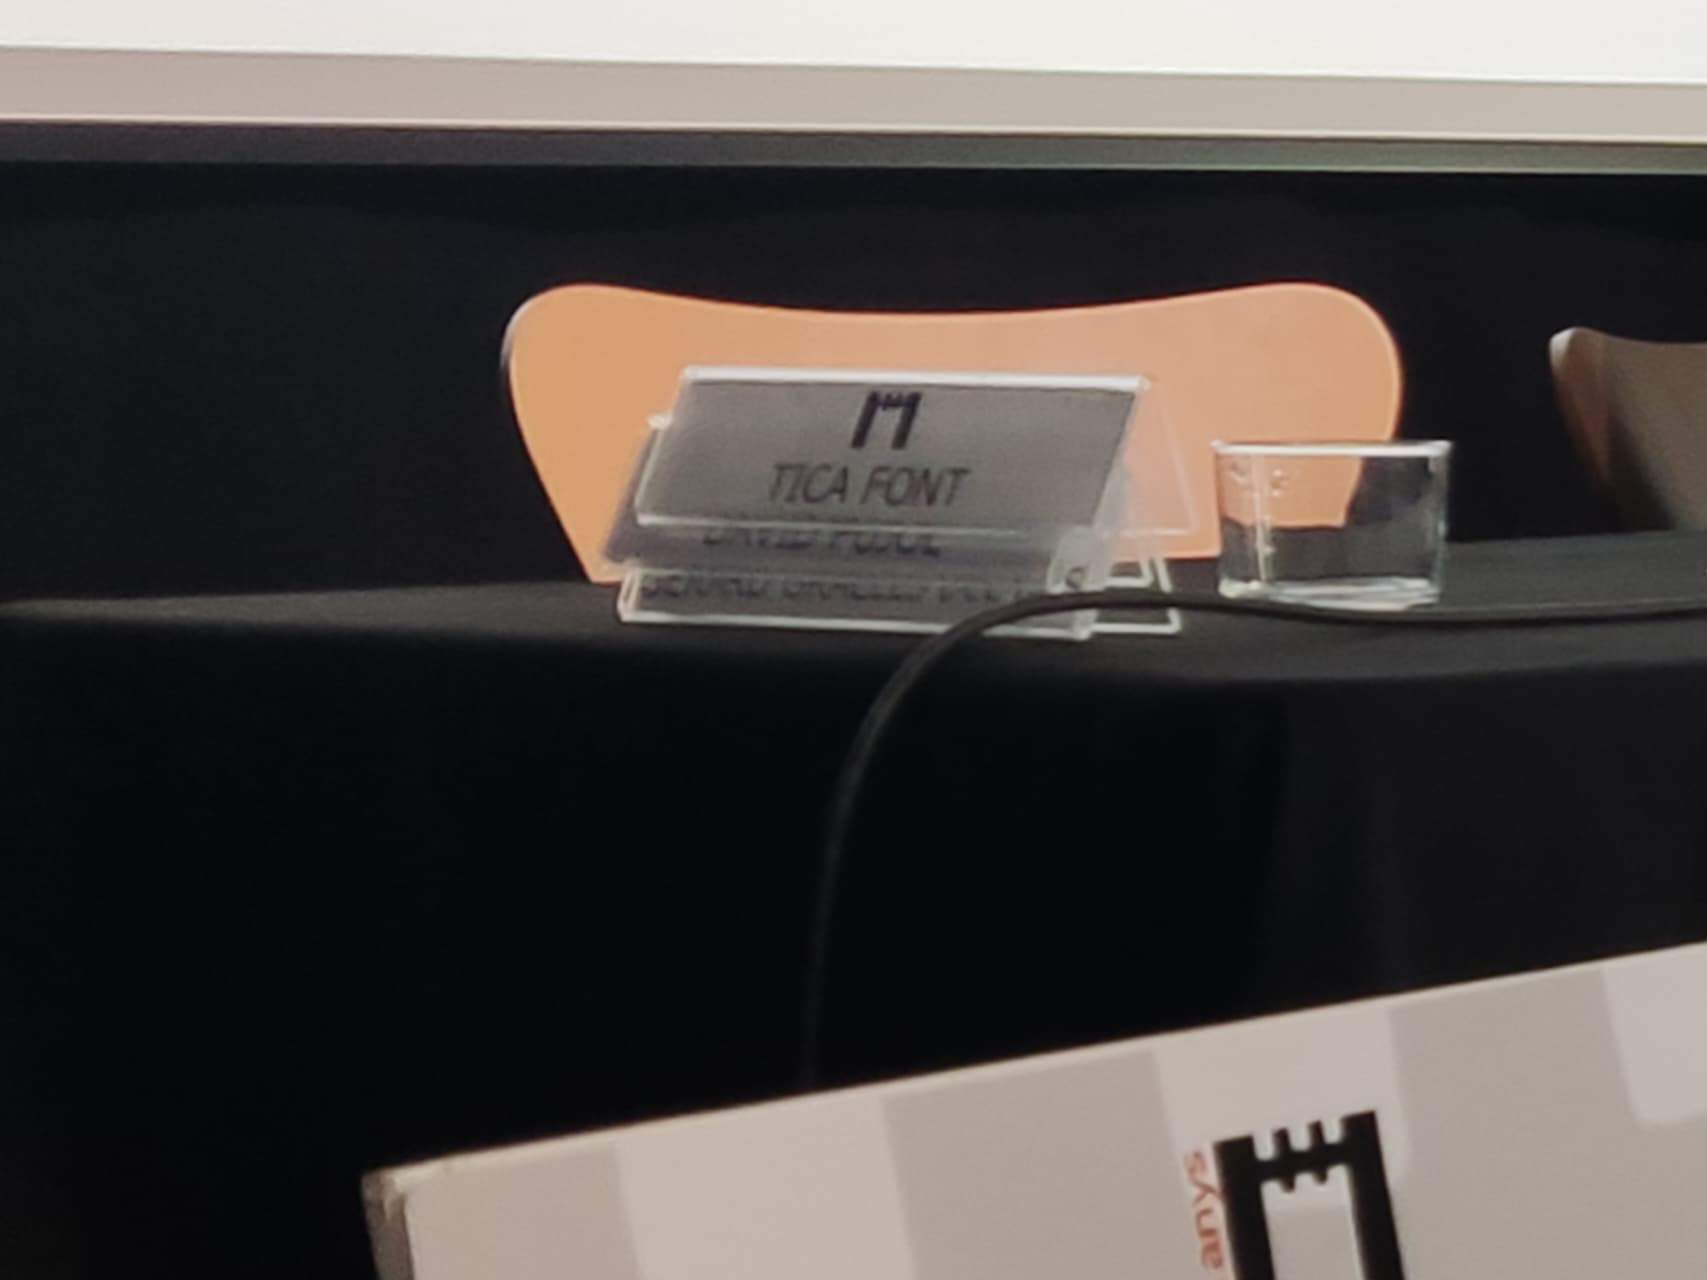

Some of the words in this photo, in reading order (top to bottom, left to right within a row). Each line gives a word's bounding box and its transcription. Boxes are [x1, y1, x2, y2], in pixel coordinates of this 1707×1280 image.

[770, 463, 848, 505] TICA
[860, 465, 970, 507] FONT
[1184, 1151, 1224, 1269] anys
